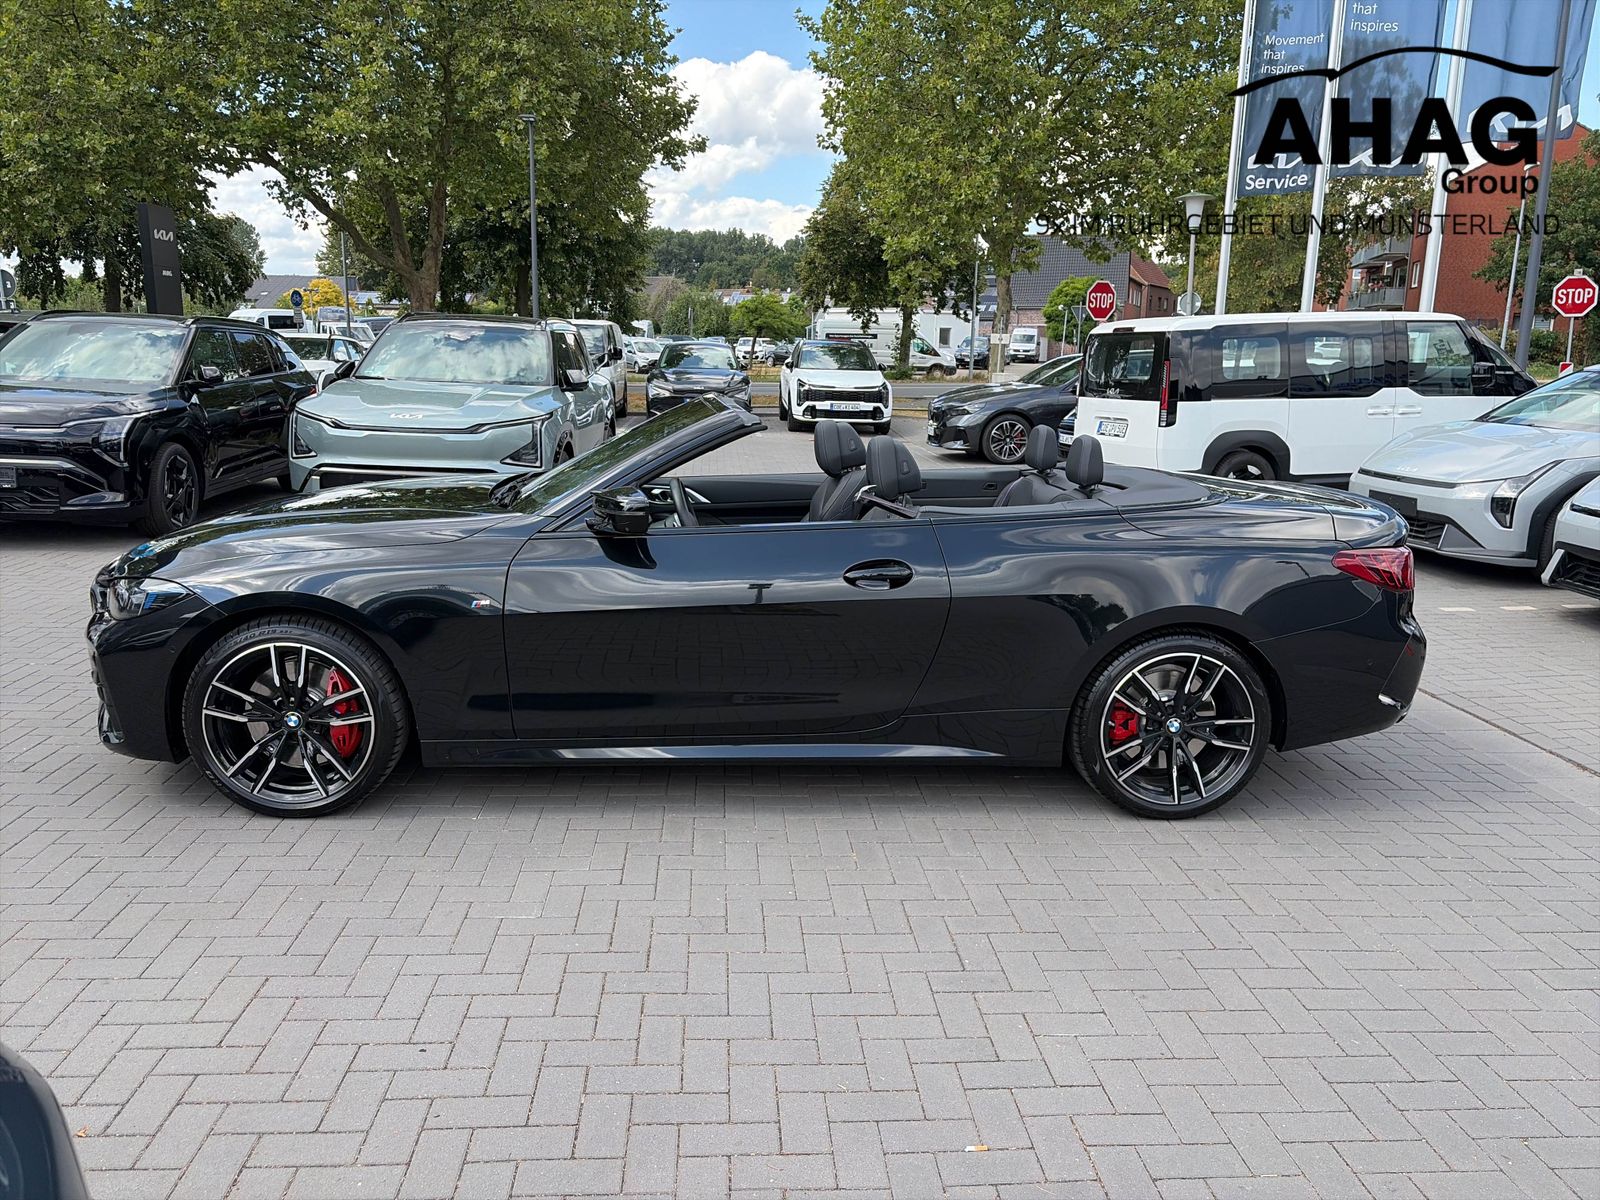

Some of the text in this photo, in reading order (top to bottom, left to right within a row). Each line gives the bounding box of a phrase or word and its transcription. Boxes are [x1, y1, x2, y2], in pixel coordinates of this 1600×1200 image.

[1352, 3, 1378, 15] that
[1350, 19, 1399, 34] inspires
[1265, 33, 1325, 46] Movement
[1263, 50, 1286, 60] that
[1261, 64, 1305, 75] inspires
[1245, 174, 1308, 190] Service
[154, 228, 174, 242] KIA
[1089, 293, 1113, 308] STOP
[1557, 288, 1593, 305] STOP
